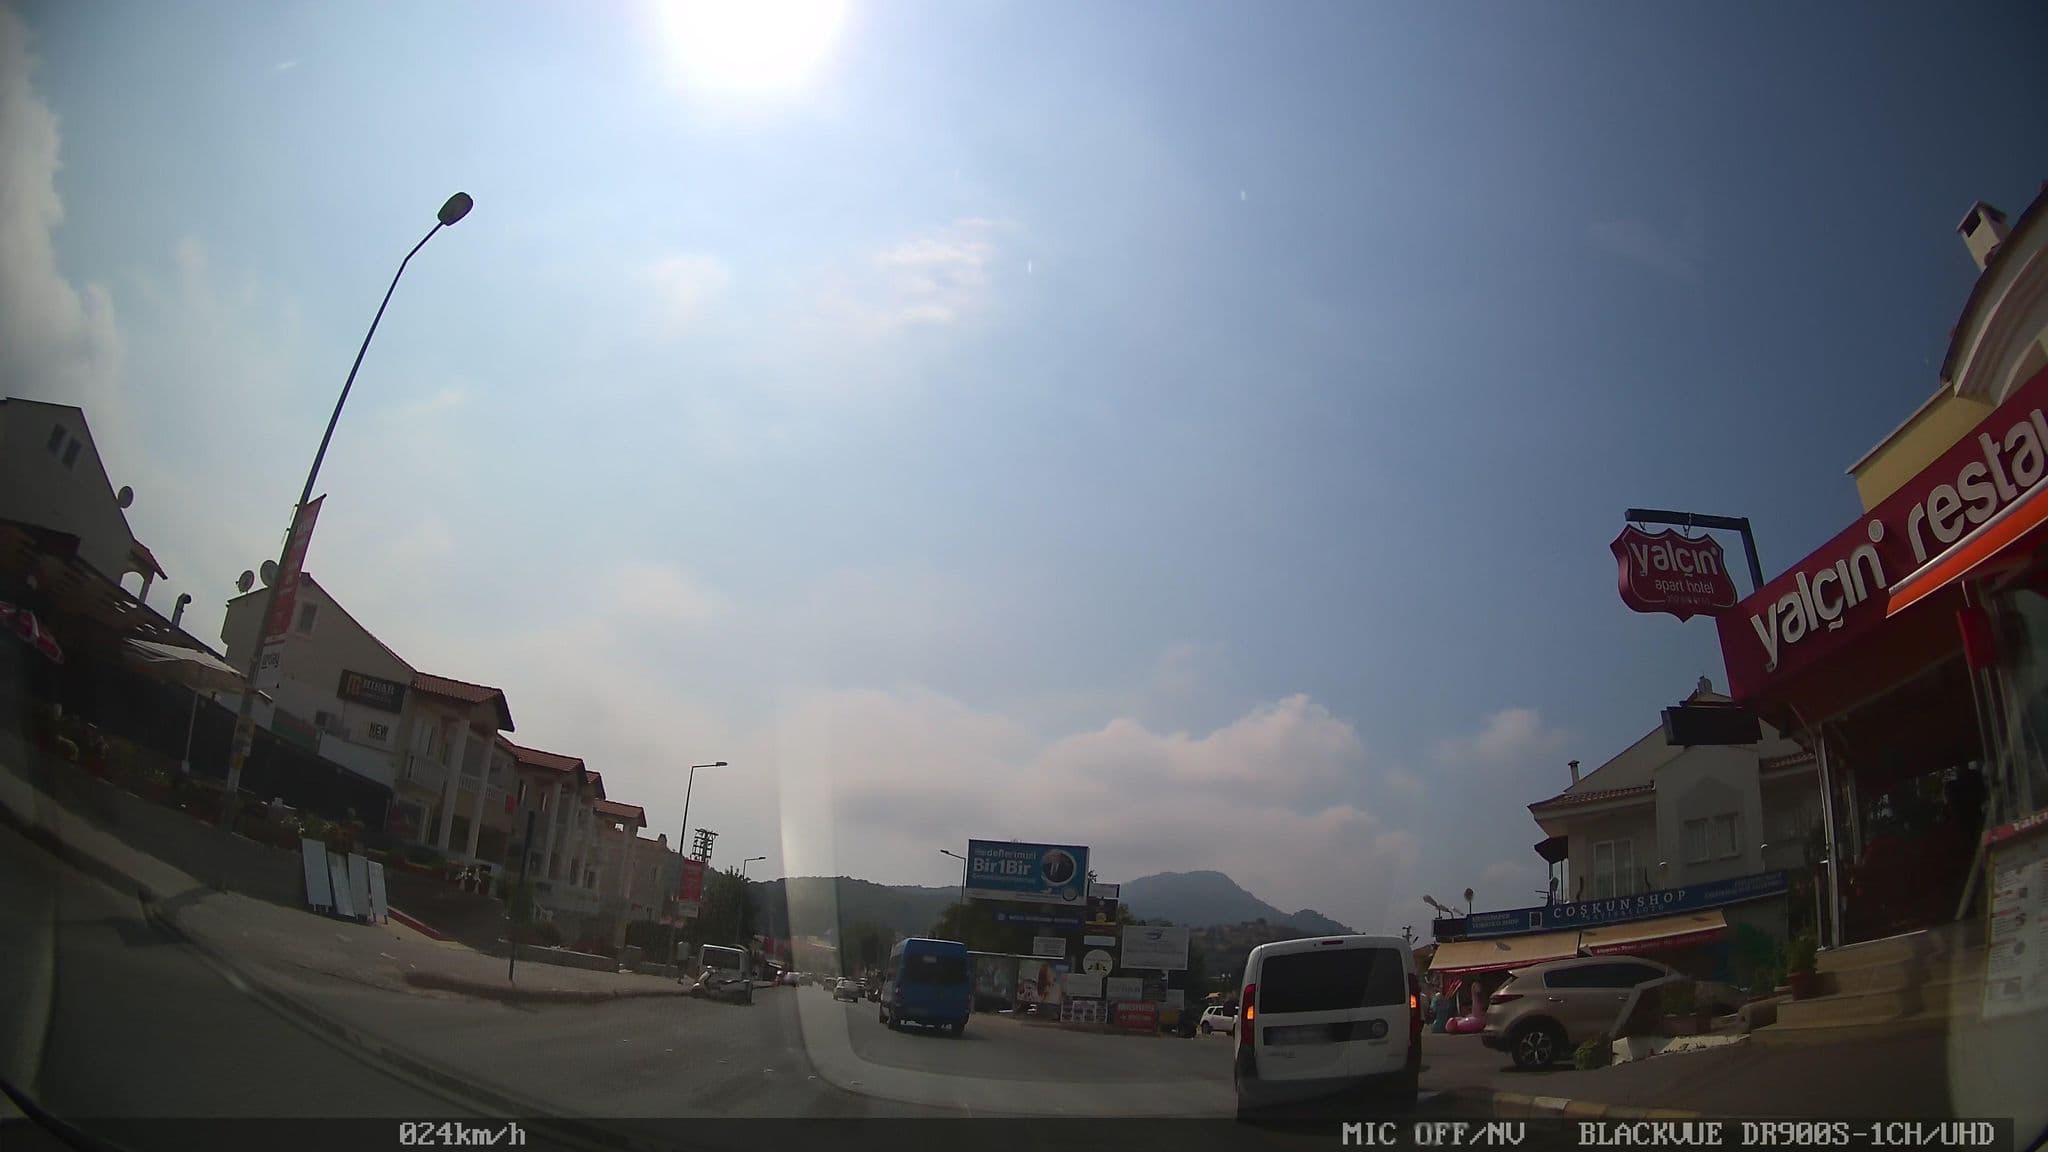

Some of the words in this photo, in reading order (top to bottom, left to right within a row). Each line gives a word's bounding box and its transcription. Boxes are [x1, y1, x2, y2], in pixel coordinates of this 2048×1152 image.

[1655, 579, 1684, 594] apart
[1685, 579, 1715, 595] hotel
[1636, 890, 1687, 908] SHOP
